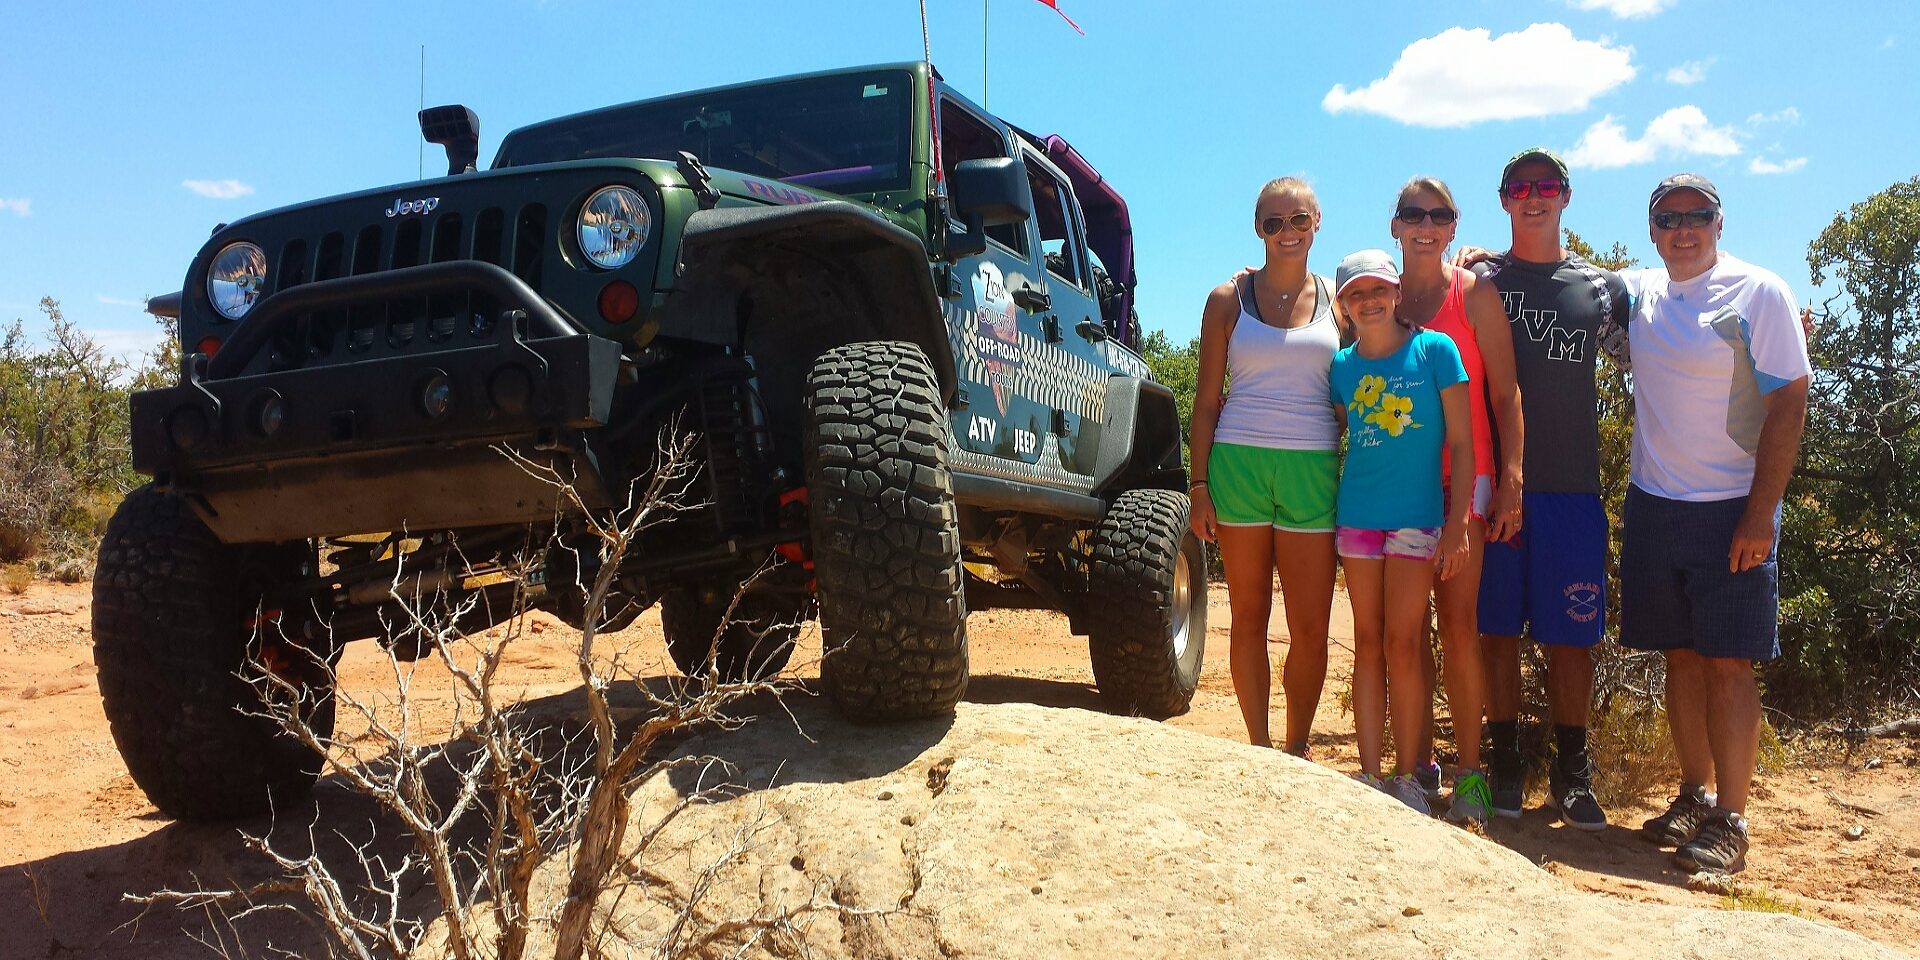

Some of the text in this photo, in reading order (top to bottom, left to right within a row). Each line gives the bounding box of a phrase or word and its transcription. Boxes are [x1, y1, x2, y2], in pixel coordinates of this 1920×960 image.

[385, 197, 440, 217] Jeep
[1499, 291, 1587, 362] UVM
[978, 336, 1021, 363] OFF-ROAD
[968, 412, 1037, 455] ATV JEEP
